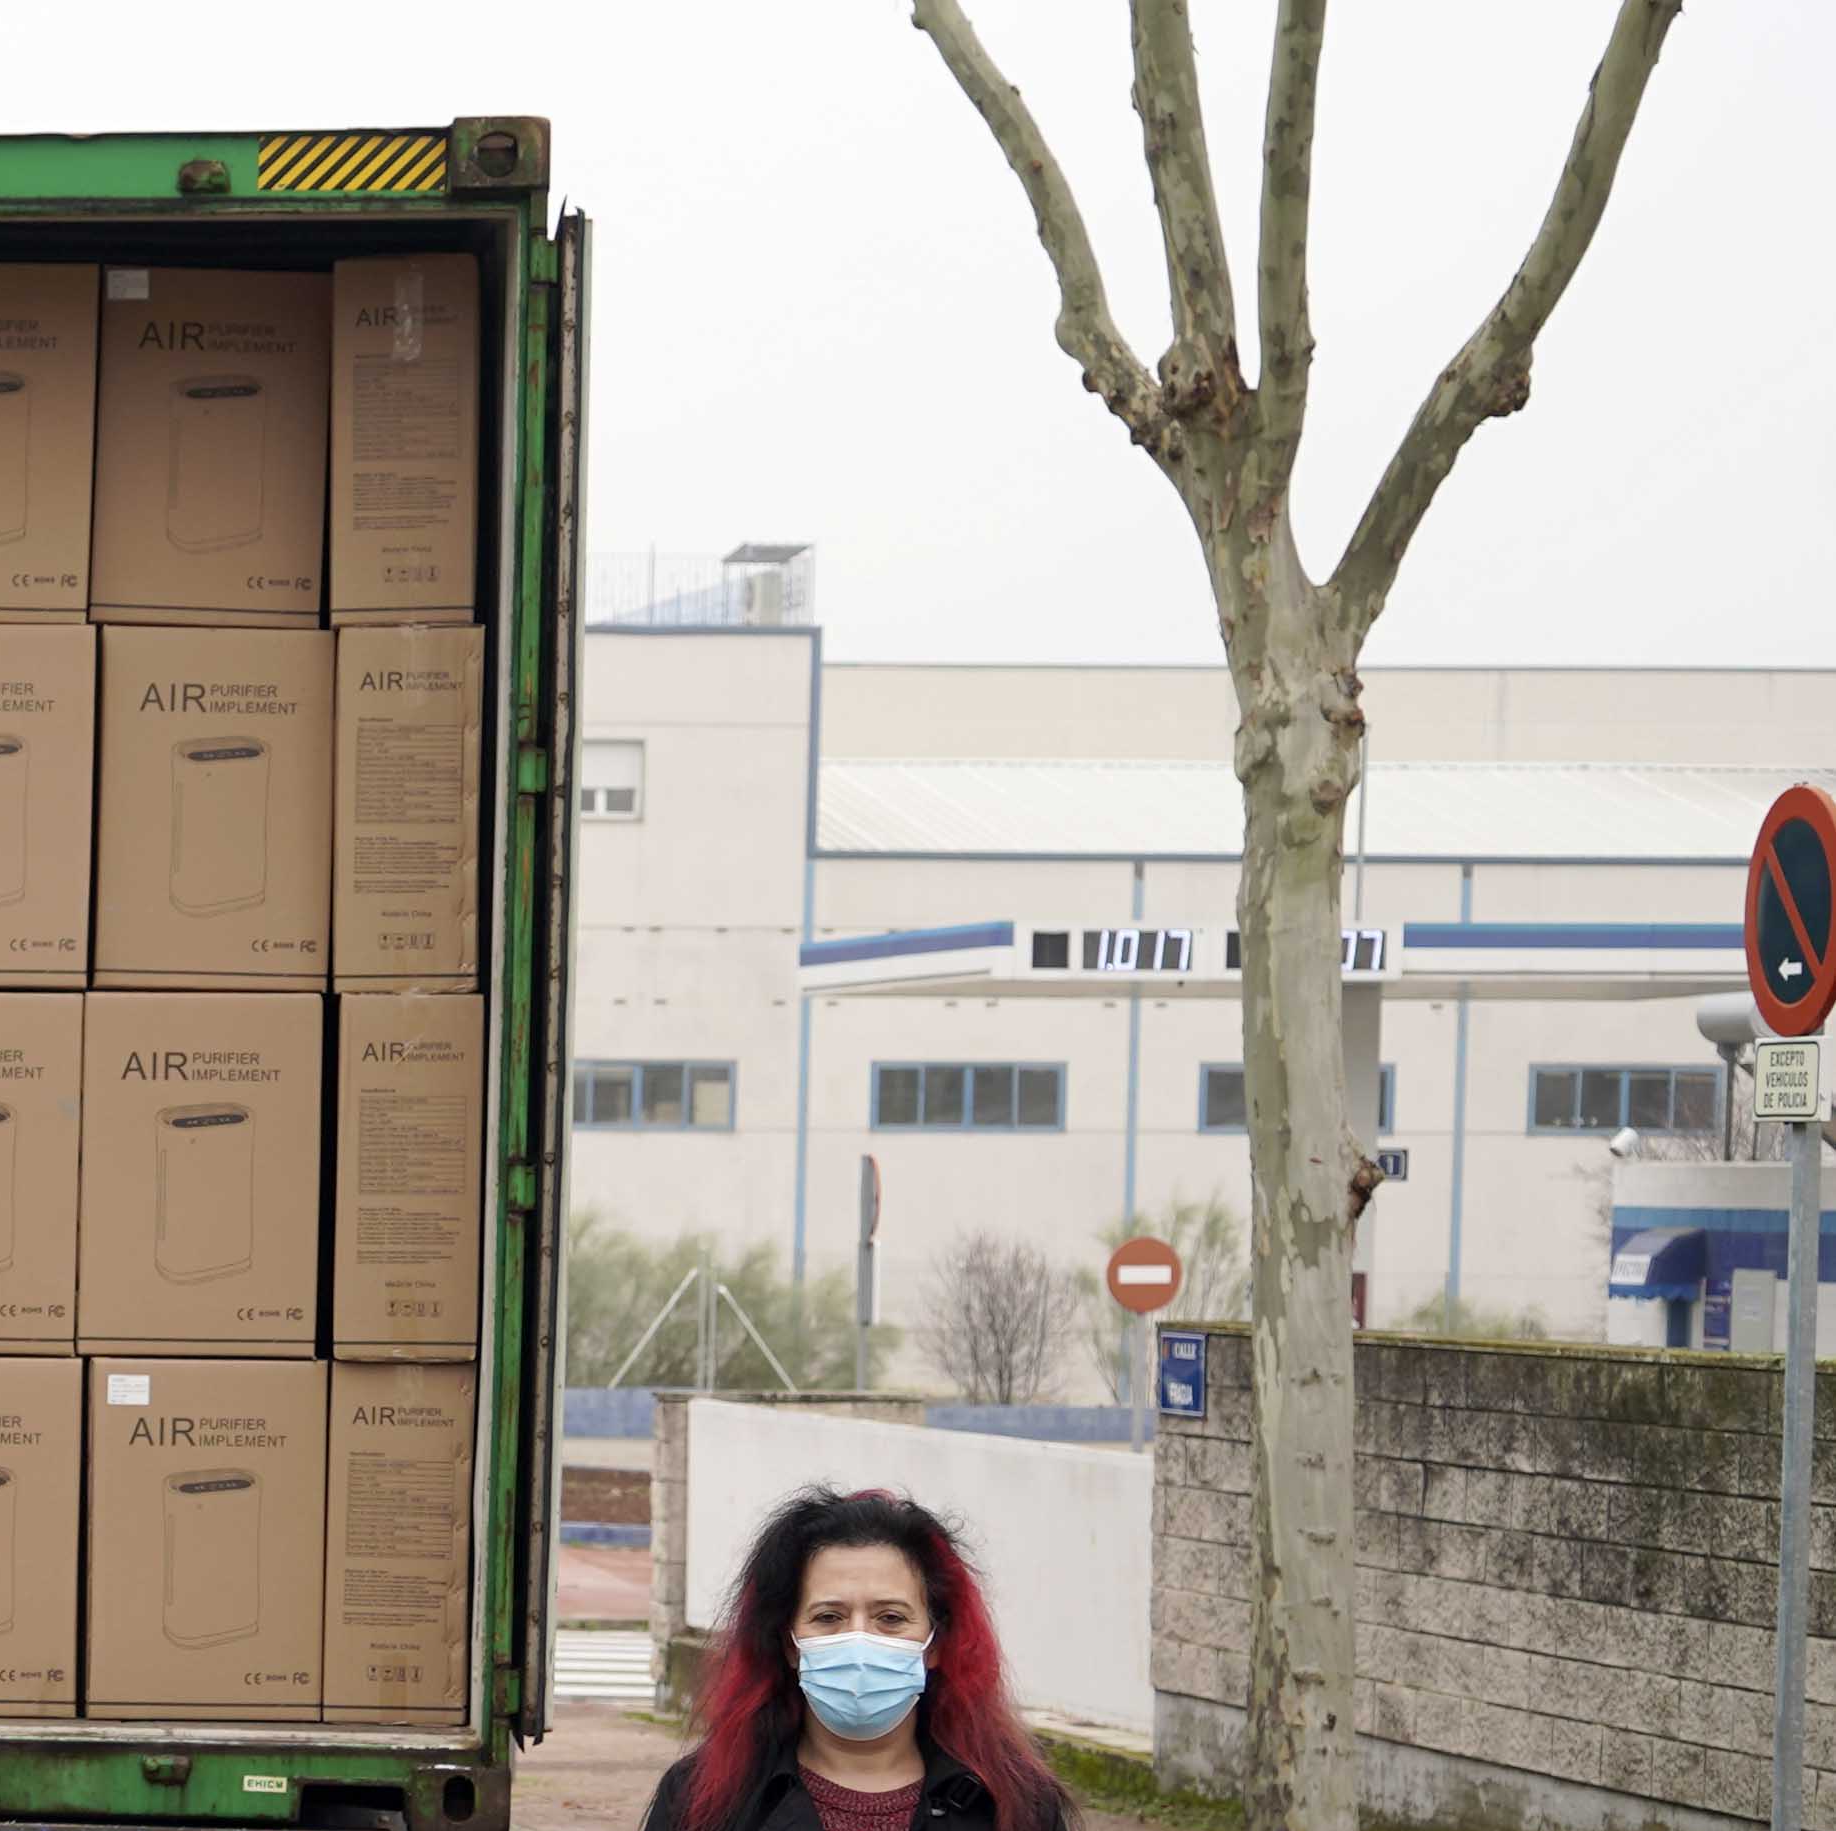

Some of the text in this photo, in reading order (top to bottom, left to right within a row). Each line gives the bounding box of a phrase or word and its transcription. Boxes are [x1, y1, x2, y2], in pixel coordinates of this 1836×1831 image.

[355, 306, 400, 328] AIR
[138, 321, 205, 351] AIR
[359, 671, 403, 691] AIR
[140, 683, 207, 713] AIR
[362, 1042, 407, 1062] AIR
[1770, 1051, 1804, 1066] EXCEPTO
[121, 1051, 260, 1081] AIR PURIFIER
[191, 1068, 281, 1082] IMPLEMENT
[1764, 1093, 1773, 1108] DE
[352, 1406, 395, 1426] AIR
[129, 1417, 266, 1446] AIR PURIFIER
[198, 1432, 287, 1448] IMPLEMENT
